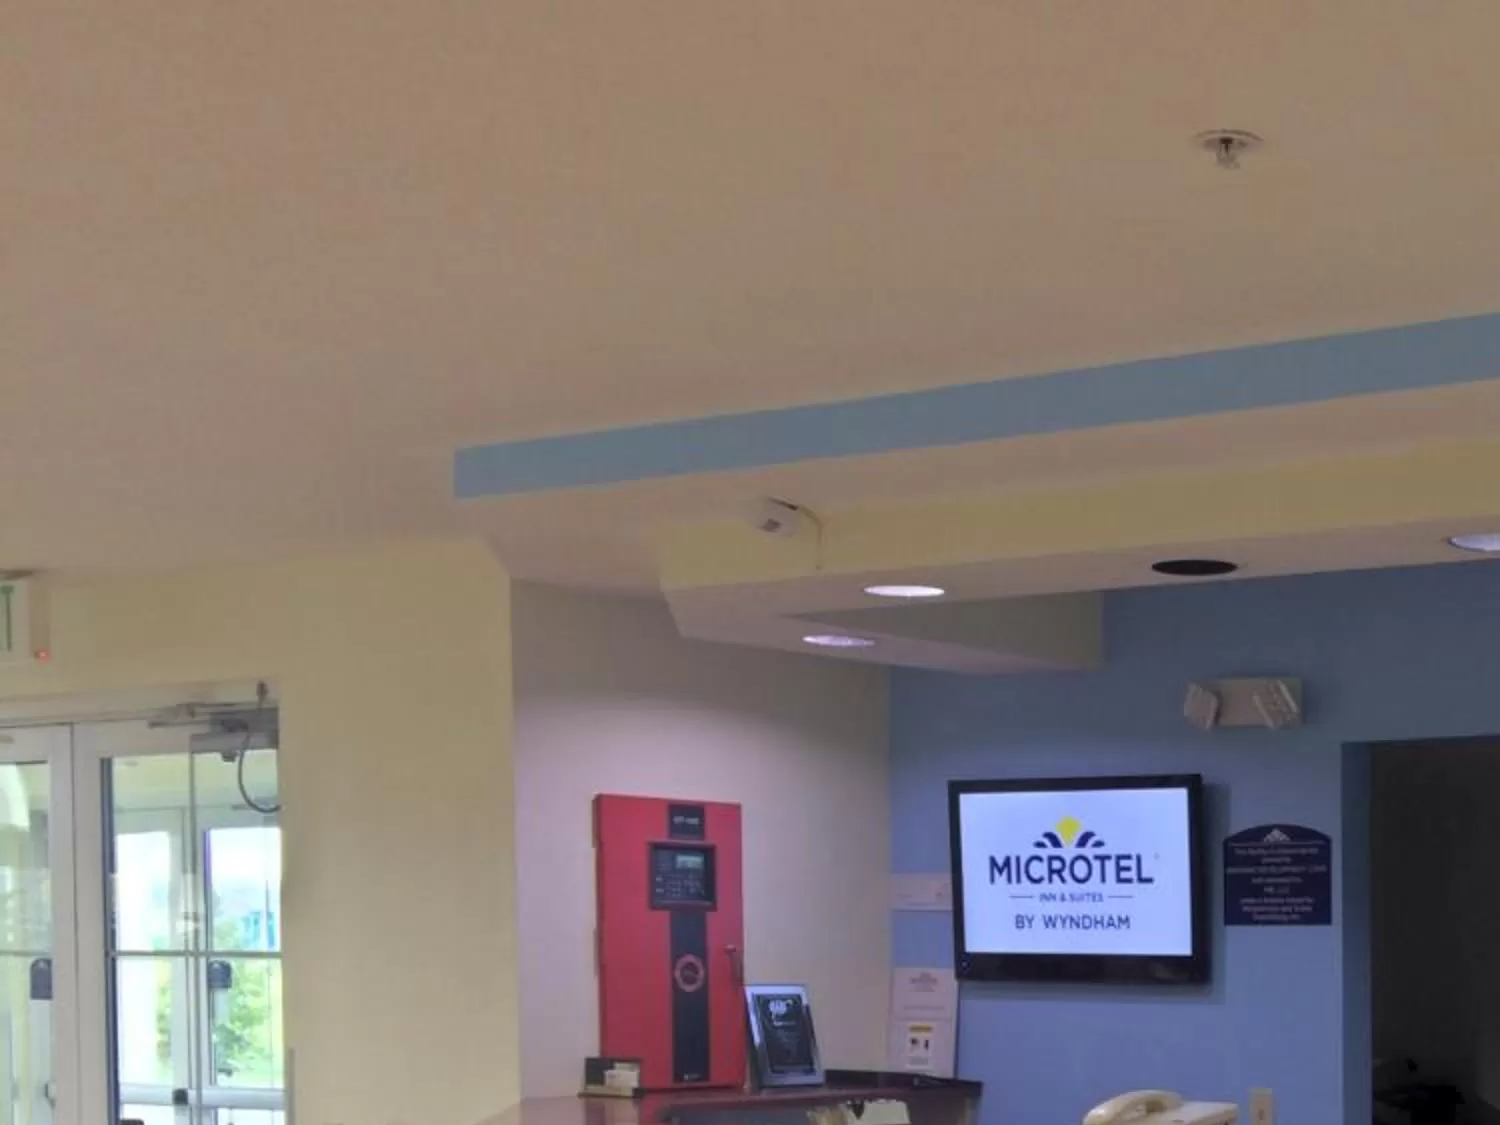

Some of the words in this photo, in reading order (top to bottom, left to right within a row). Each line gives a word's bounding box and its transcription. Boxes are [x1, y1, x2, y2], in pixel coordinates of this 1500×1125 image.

[988, 853, 1155, 886] MICROTEL
[1015, 914, 1035, 930] BY
[1043, 914, 1131, 930] WYNDHAM
